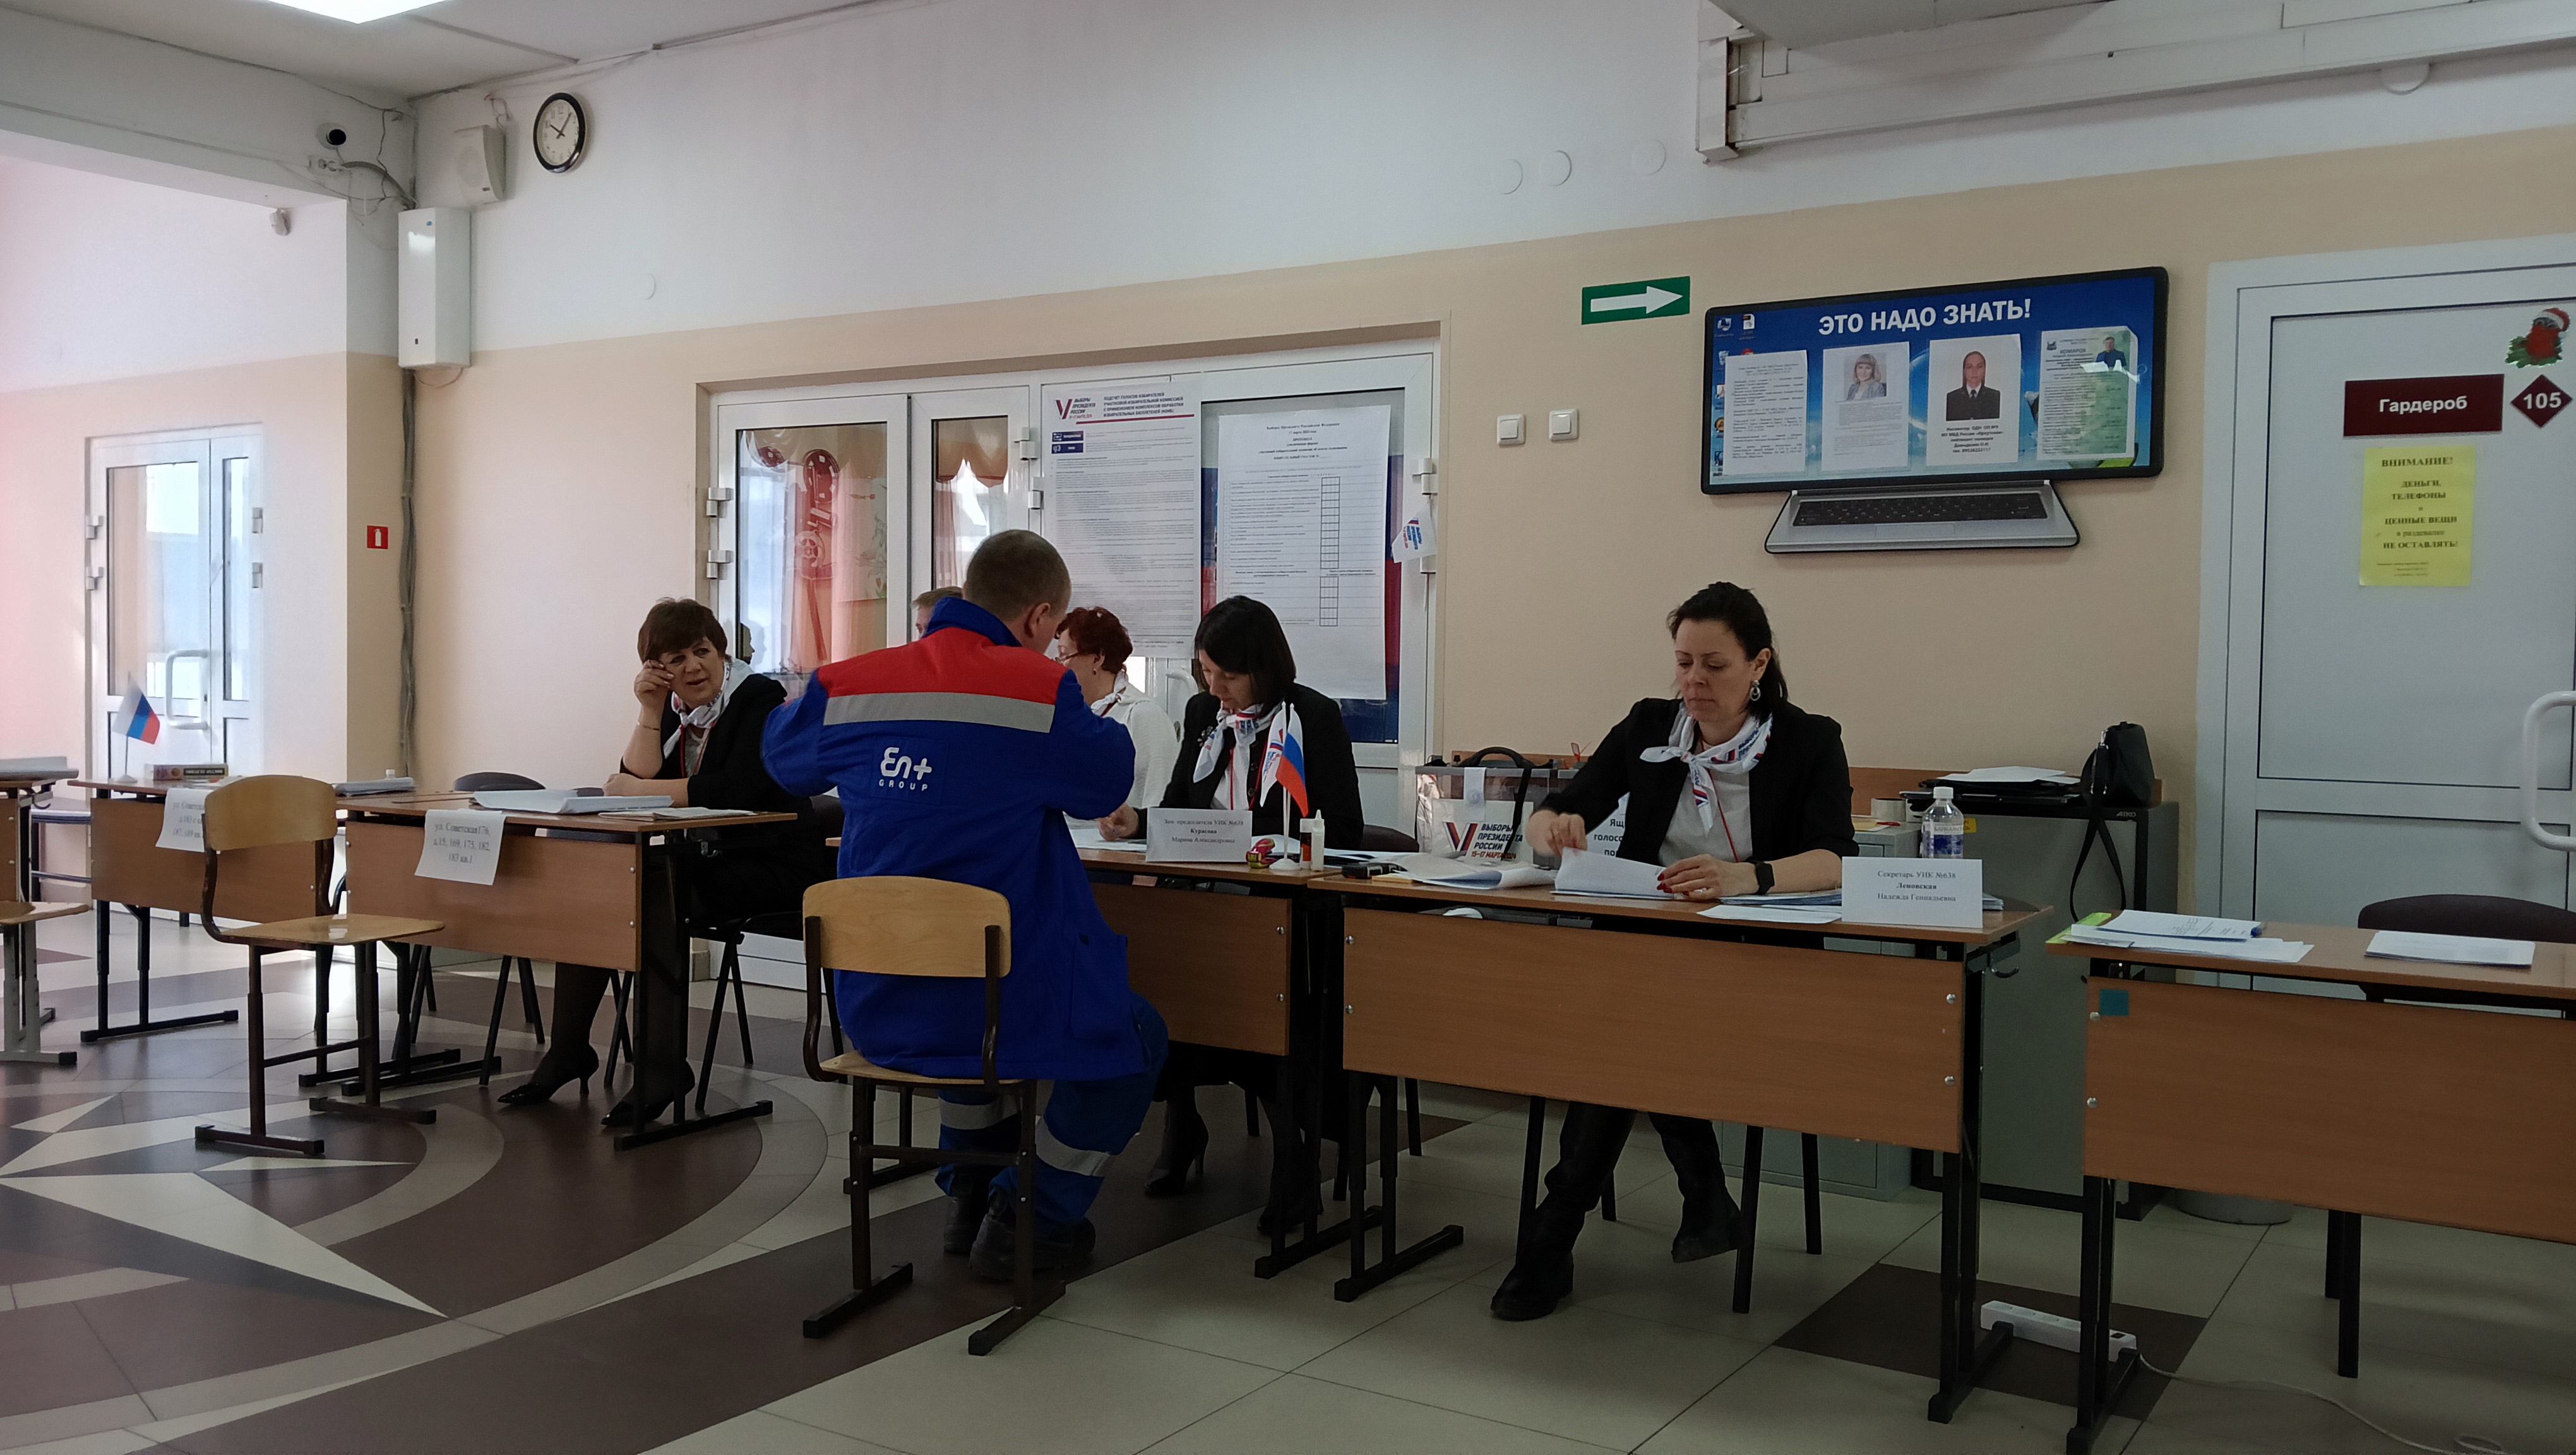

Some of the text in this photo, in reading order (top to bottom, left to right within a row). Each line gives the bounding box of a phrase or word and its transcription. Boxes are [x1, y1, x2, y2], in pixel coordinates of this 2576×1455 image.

[1818, 299, 2031, 335] ЭТО НАДО ЗНАТЬ!
[2379, 395, 2467, 415] Гардероб
[2524, 392, 2562, 409] 105
[2382, 457, 2454, 467] ВНИМАНИЕ!
[2401, 479, 2442, 488] ДЕНЬГИ,
[2392, 492, 2446, 500] ТЕЛЕФОНЫ
[2385, 517, 2425, 525] ЦЕННЫЕ
[2398, 541, 2458, 549] ОСТАВЛЯТЬ!
[878, 779, 928, 791] GROUP
[1610, 818, 1625, 829] Ящ
[1477, 833, 1523, 842] ПРЕЗИДЕТА
[1474, 842, 1503, 851] РОССИИ
[1878, 870, 1914, 879] Секретарь
[1878, 892, 1956, 902] Надежда Геннадьевна
